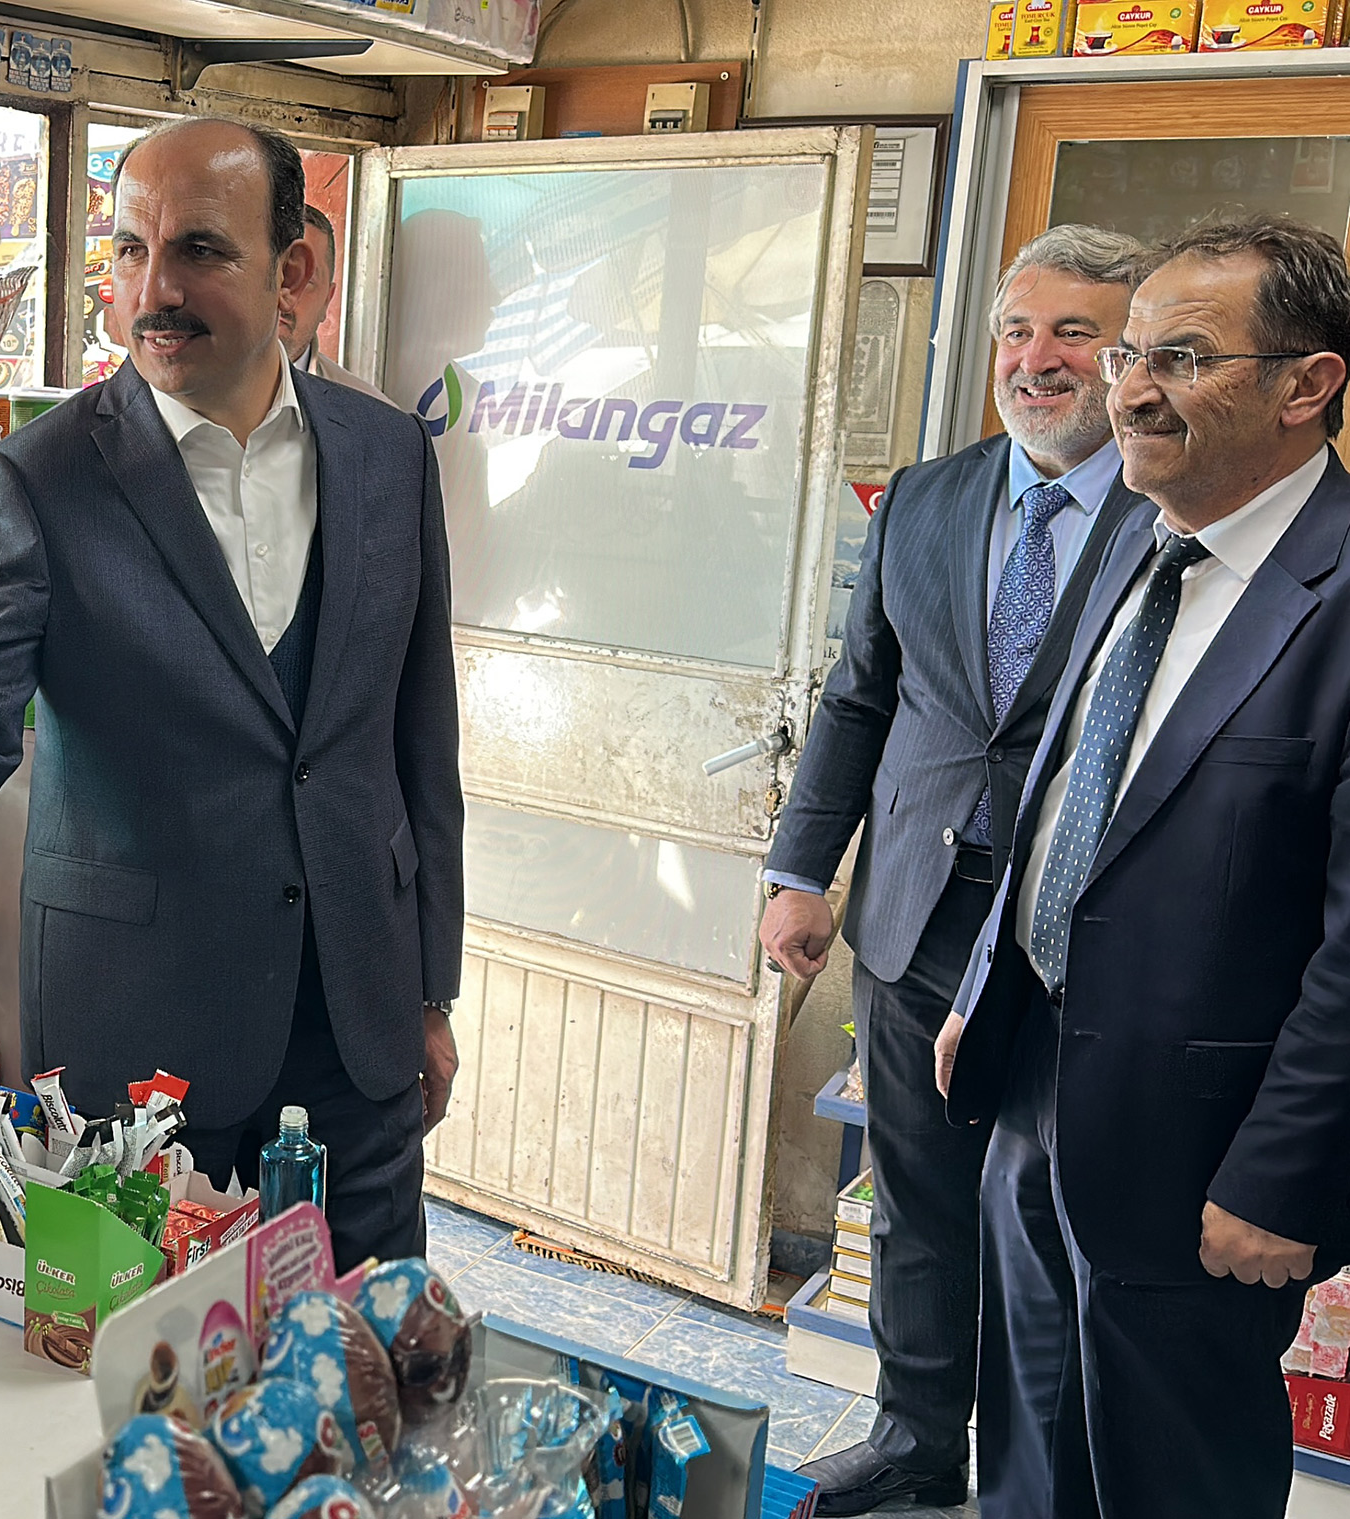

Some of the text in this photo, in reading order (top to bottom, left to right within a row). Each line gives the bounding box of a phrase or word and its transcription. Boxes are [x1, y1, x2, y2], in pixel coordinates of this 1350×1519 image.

[468, 380, 769, 470] Milangaz
[41, 1094, 69, 1133] Biscolat
[186, 1236, 212, 1269] First
[37, 1260, 76, 1285] ÜLKER
[111, 1263, 144, 1288] ÜLKER
